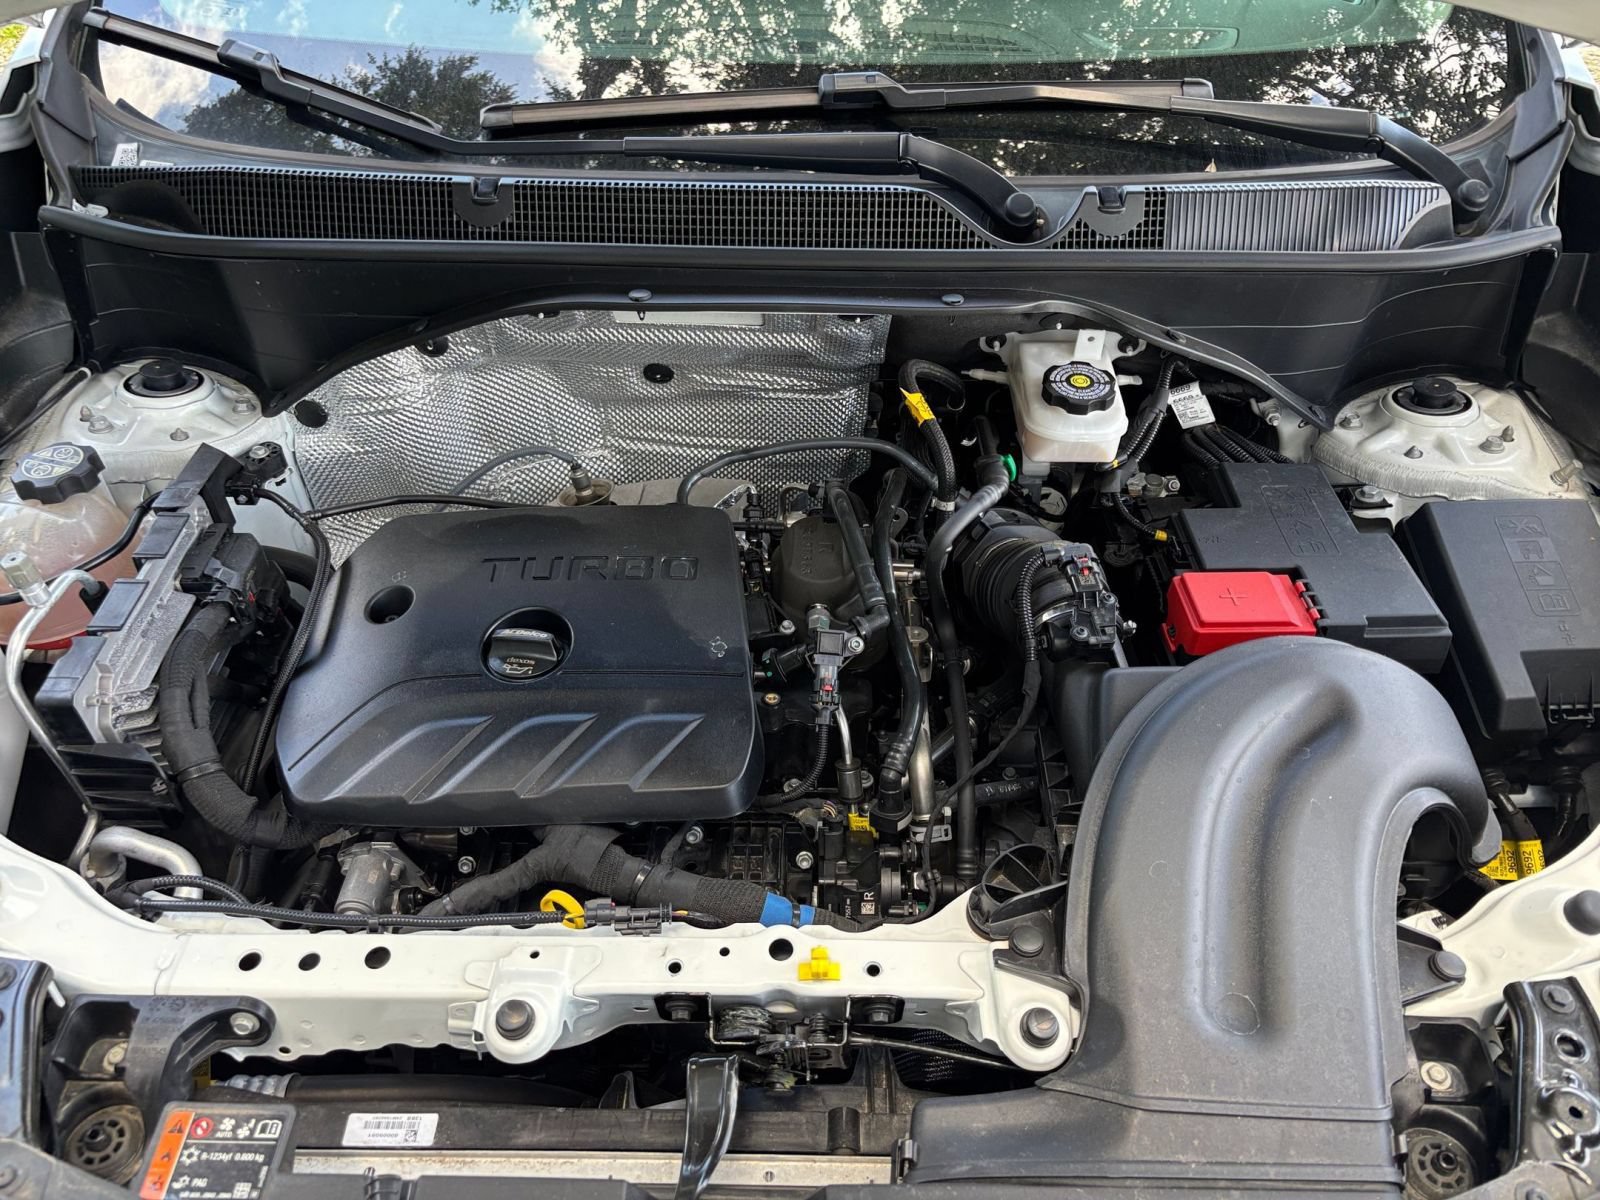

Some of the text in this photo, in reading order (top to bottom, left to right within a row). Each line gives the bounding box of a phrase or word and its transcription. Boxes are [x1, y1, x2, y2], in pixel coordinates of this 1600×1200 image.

[481, 556, 699, 582] TURBO
[1506, 850, 1517, 873] 9692
[1523, 850, 1535, 874] 9692
[864, 892, 874, 900] R
[200, 1152, 233, 1162] R-1234yf
[254, 1153, 265, 1163] kg
[191, 1178, 208, 1187] PAG
